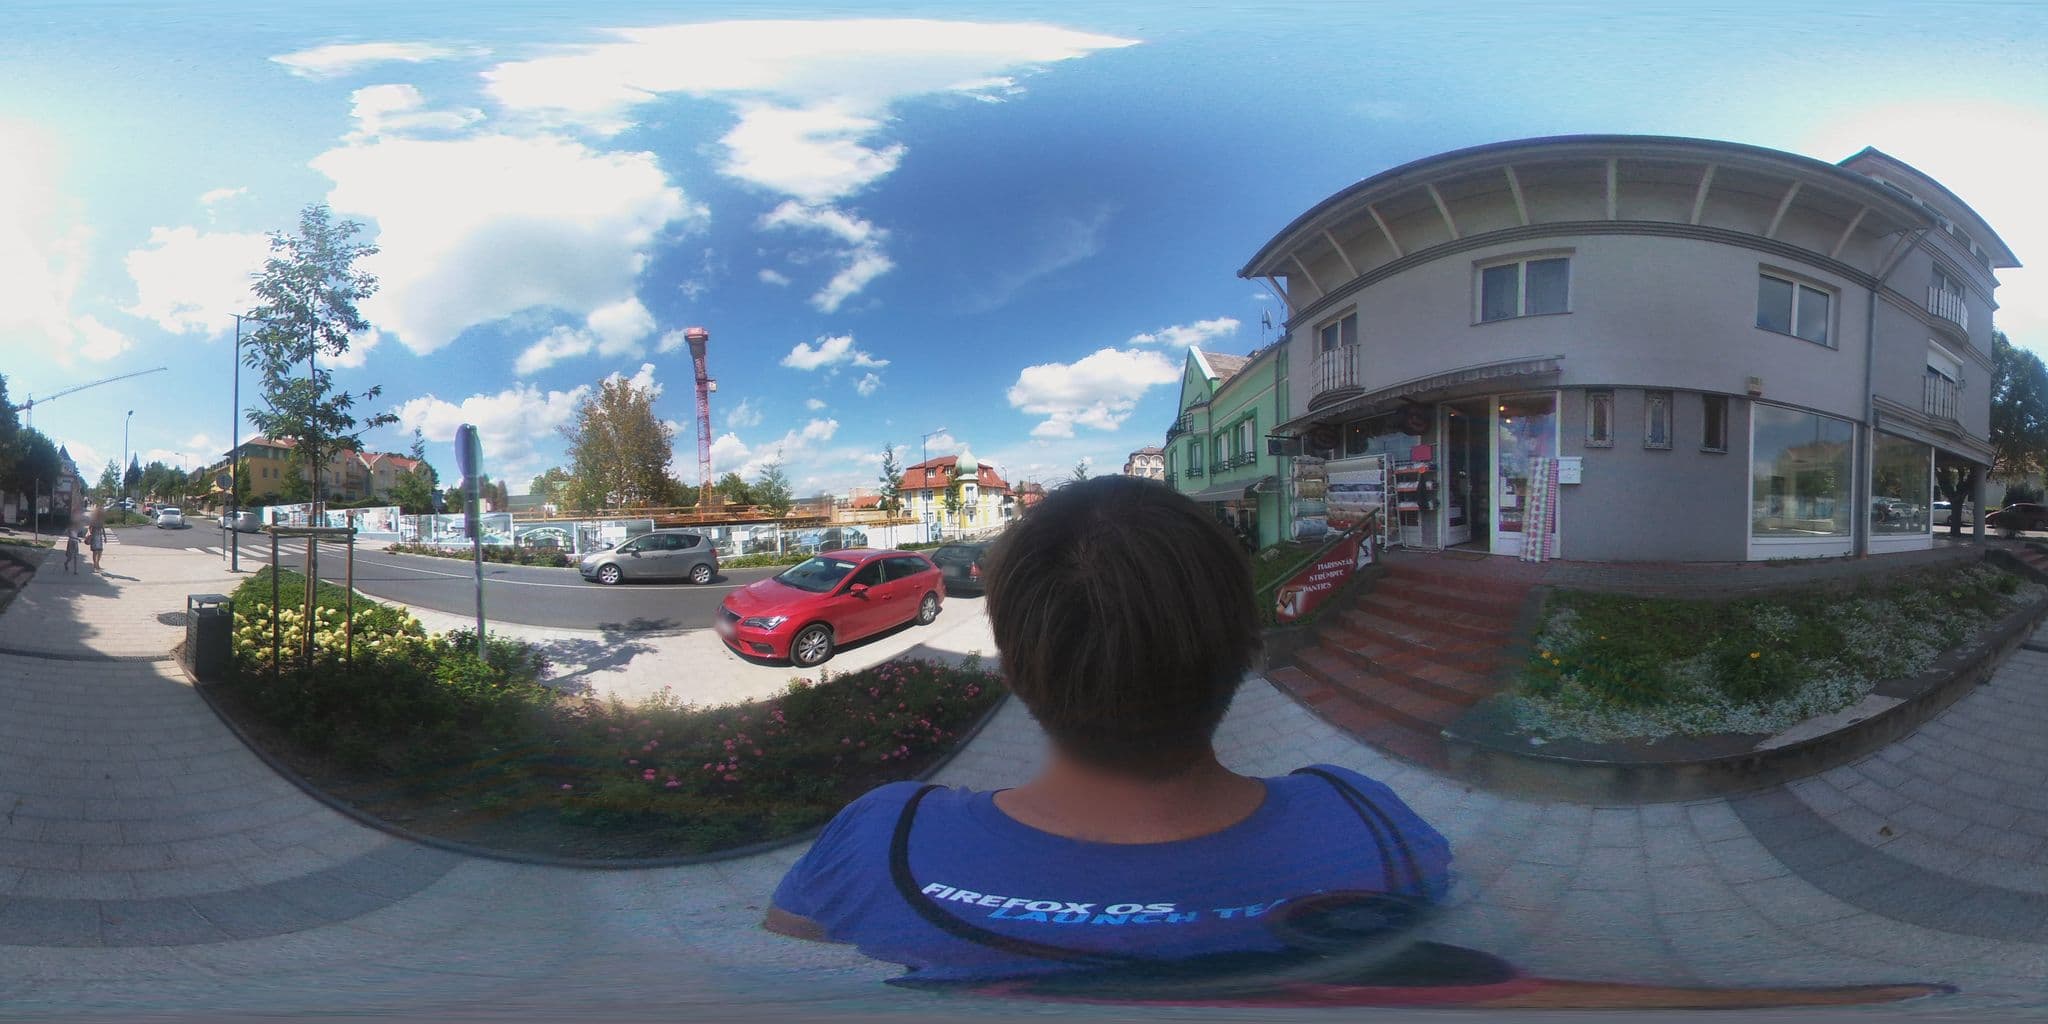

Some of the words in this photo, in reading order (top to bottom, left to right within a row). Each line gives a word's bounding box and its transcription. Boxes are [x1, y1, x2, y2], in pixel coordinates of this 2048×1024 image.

[921, 882, 1096, 914] FIREFOX
[1105, 903, 1177, 914] OS
[987, 908, 1199, 925] LAUNCH
